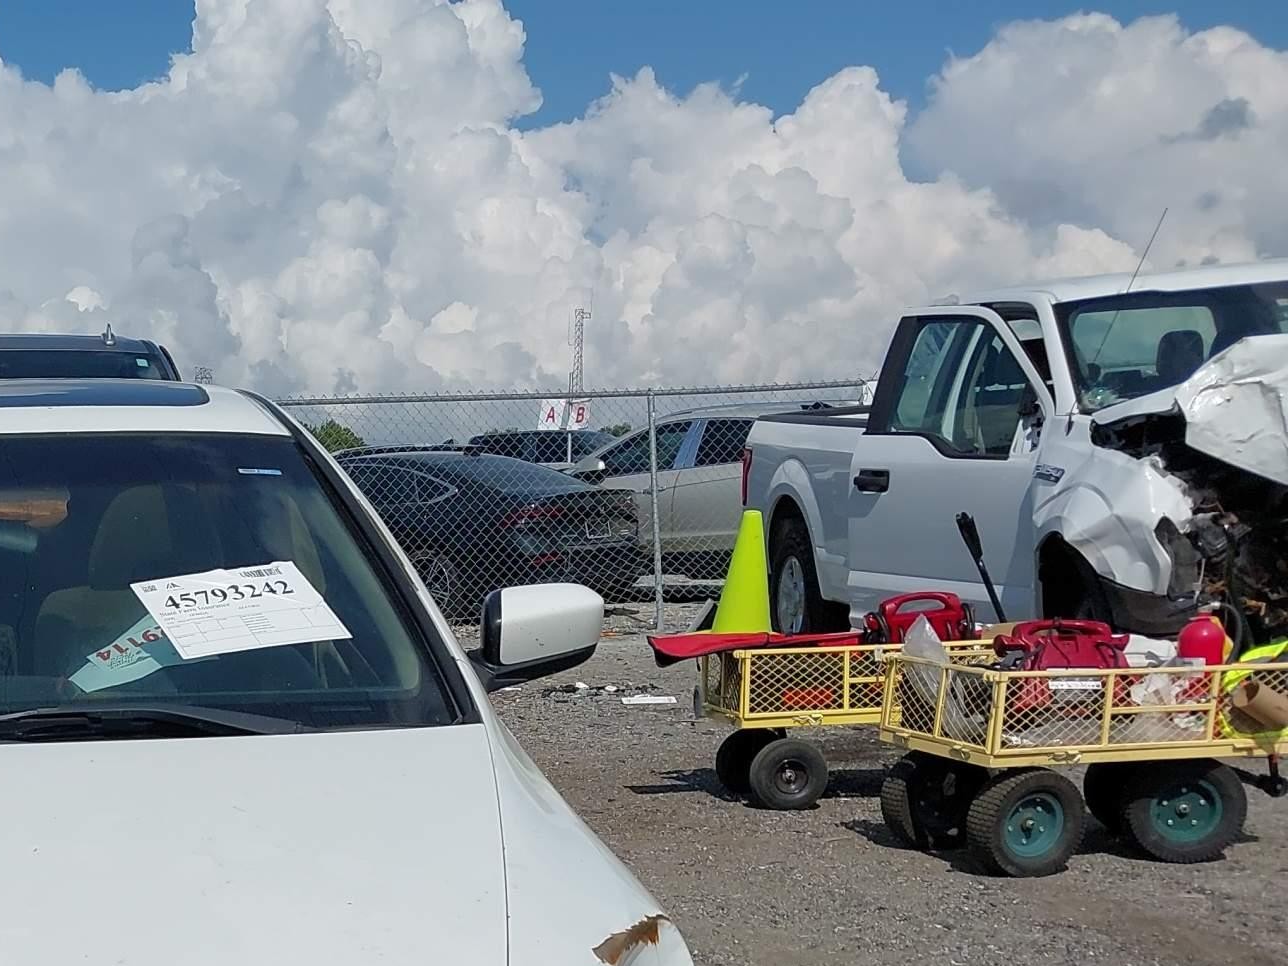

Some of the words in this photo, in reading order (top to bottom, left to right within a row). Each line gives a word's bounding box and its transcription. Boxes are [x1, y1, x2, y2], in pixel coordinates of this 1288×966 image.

[545, 406, 555, 423] A
[575, 406, 585, 423] B
[165, 580, 295, 610] 45793242
[198, 602, 230, 611] Insurance
